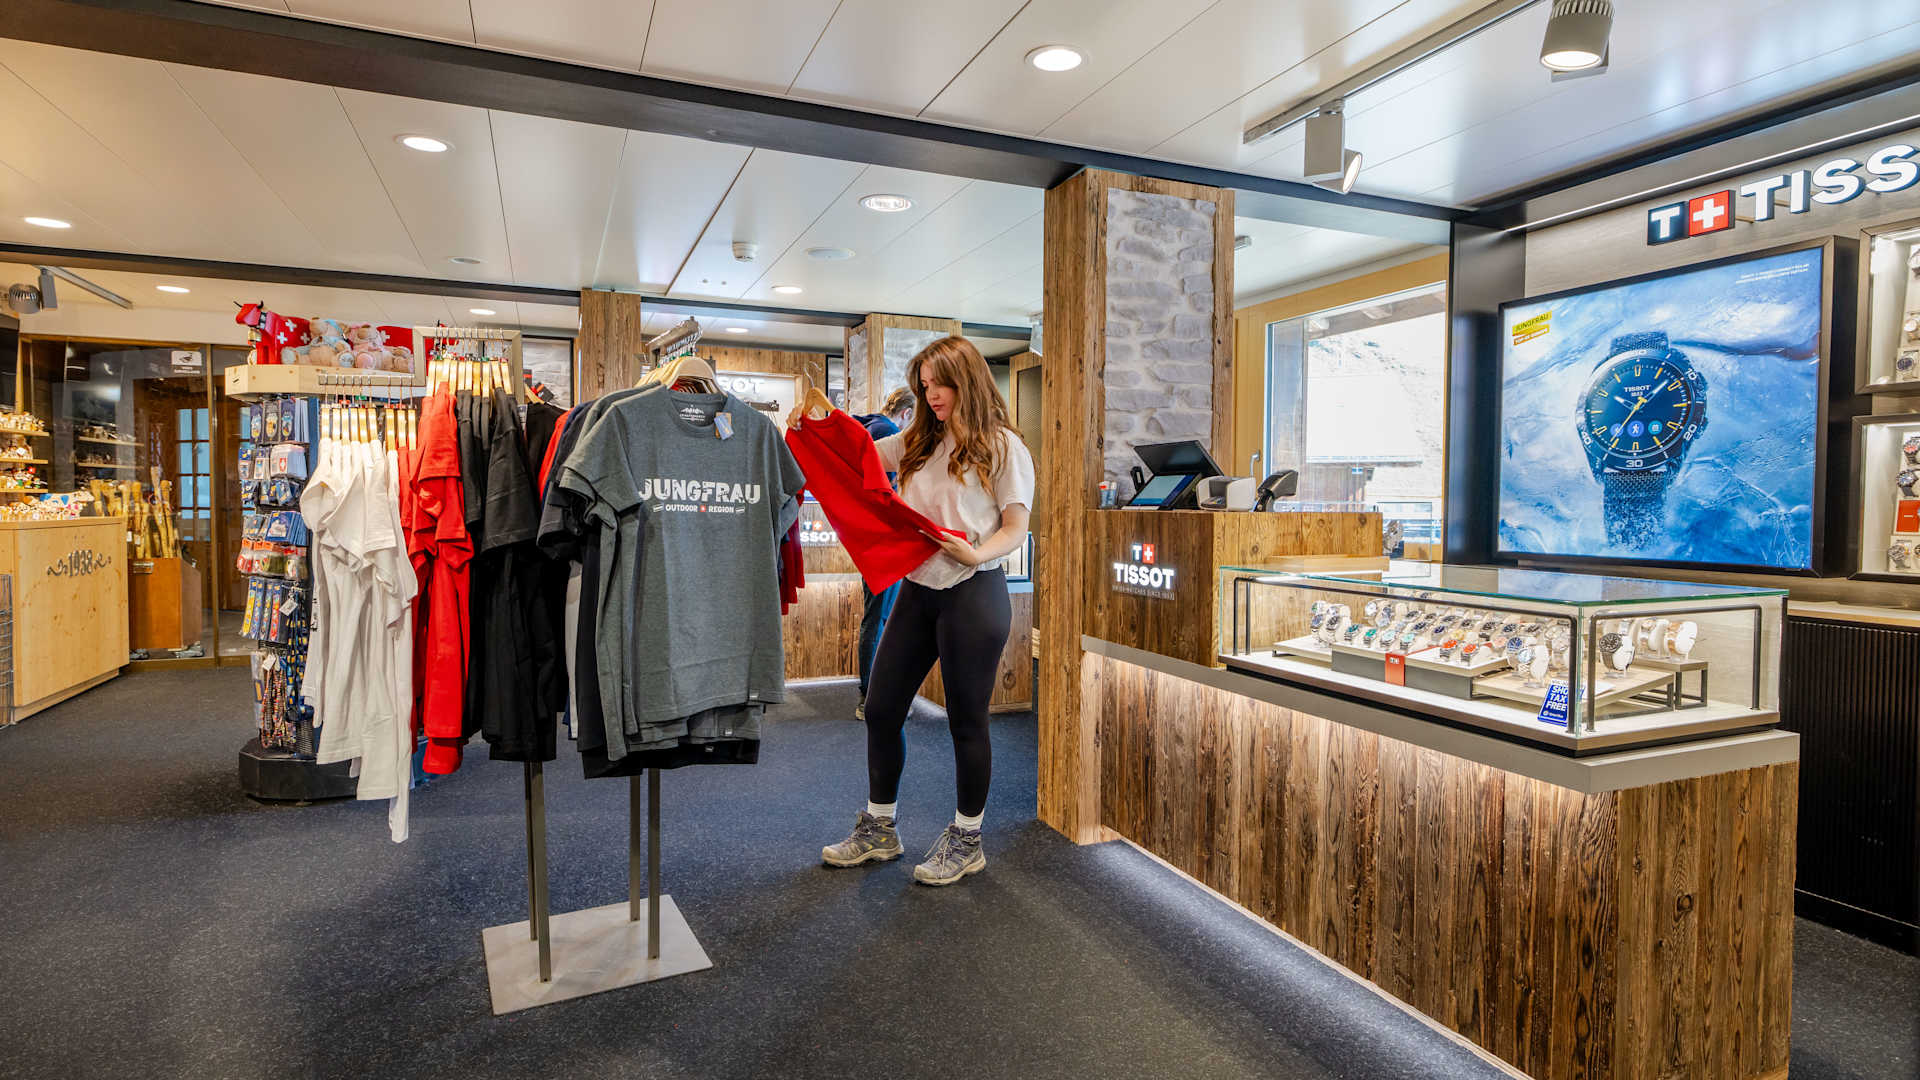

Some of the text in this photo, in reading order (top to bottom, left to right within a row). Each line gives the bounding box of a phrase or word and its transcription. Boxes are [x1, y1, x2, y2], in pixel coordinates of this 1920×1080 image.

[1651, 144, 1920, 239] T TISS
[1581, 431, 1593, 446] 40
[1683, 424, 1698, 441] 20
[1625, 459, 1644, 468] 30
[638, 478, 761, 504] JUNGFRAU
[665, 503, 735, 514] OUTDOOR REGION
[1132, 545, 1143, 561] T
[1112, 562, 1175, 590] TISSOT
[1550, 693, 1566, 702] TAX
[1545, 700, 1567, 711] FREE
